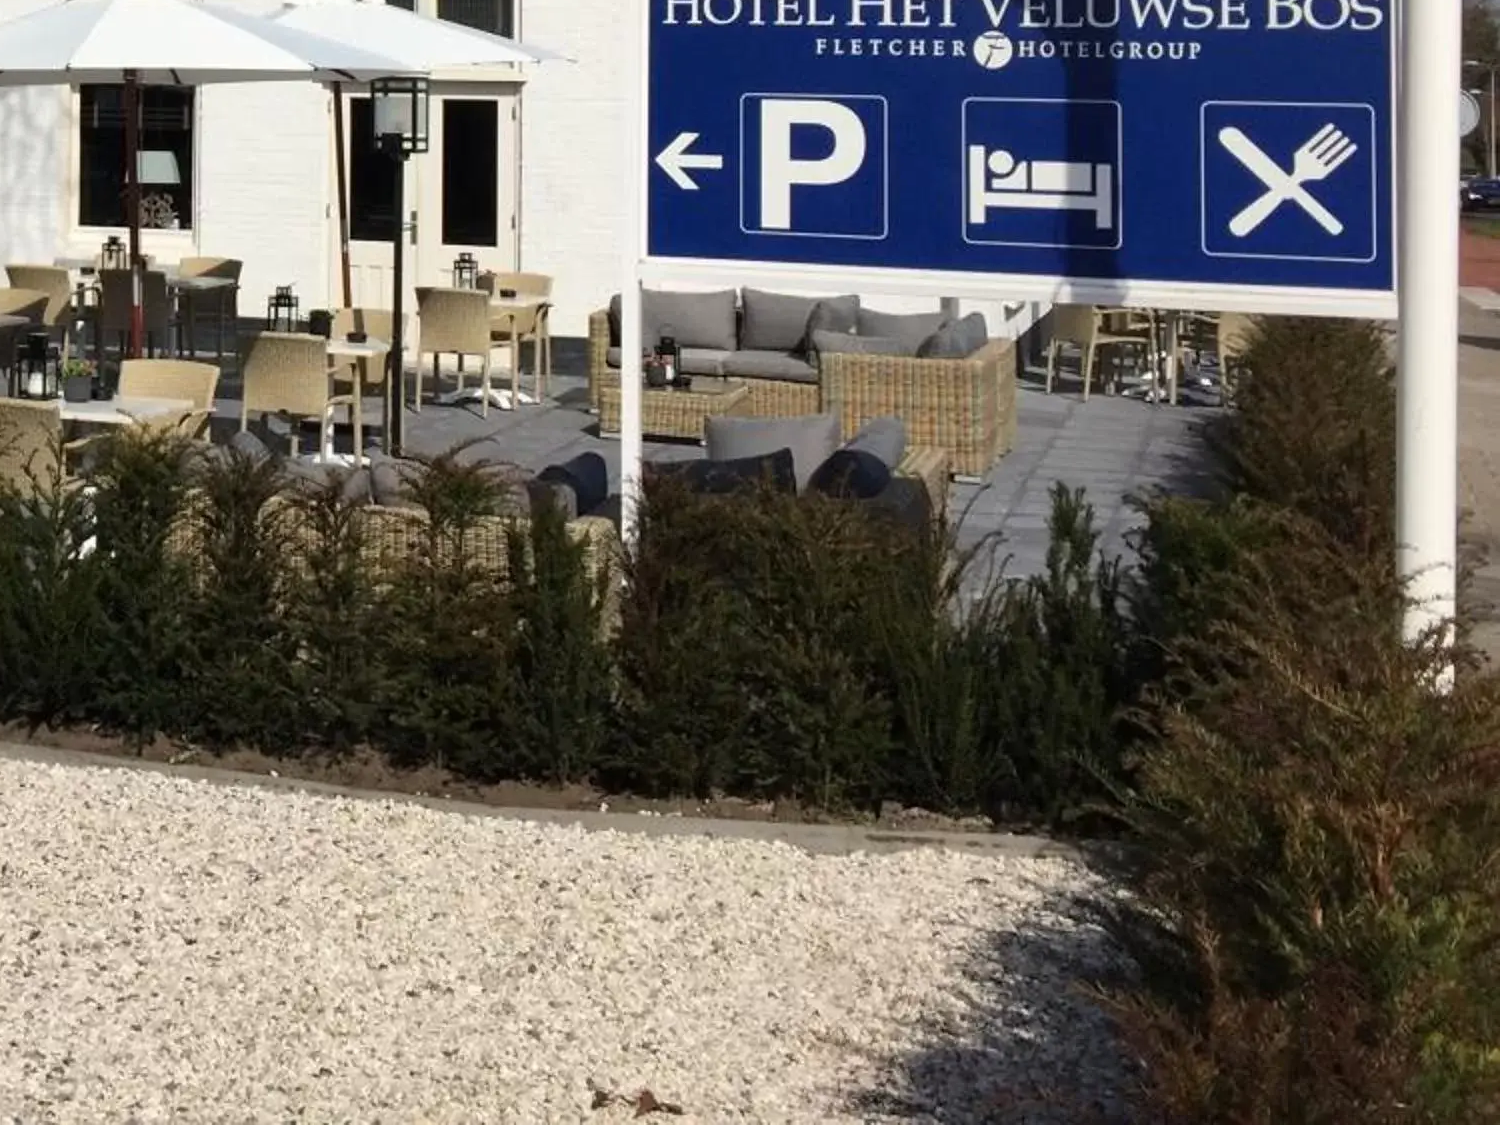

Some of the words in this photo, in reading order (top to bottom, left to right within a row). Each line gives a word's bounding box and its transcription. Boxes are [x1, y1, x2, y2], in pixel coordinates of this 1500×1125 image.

[814, 37, 968, 57] FLETCHER
[1018, 40, 1202, 60] HOTELGROUP
[760, 98, 867, 230] P
